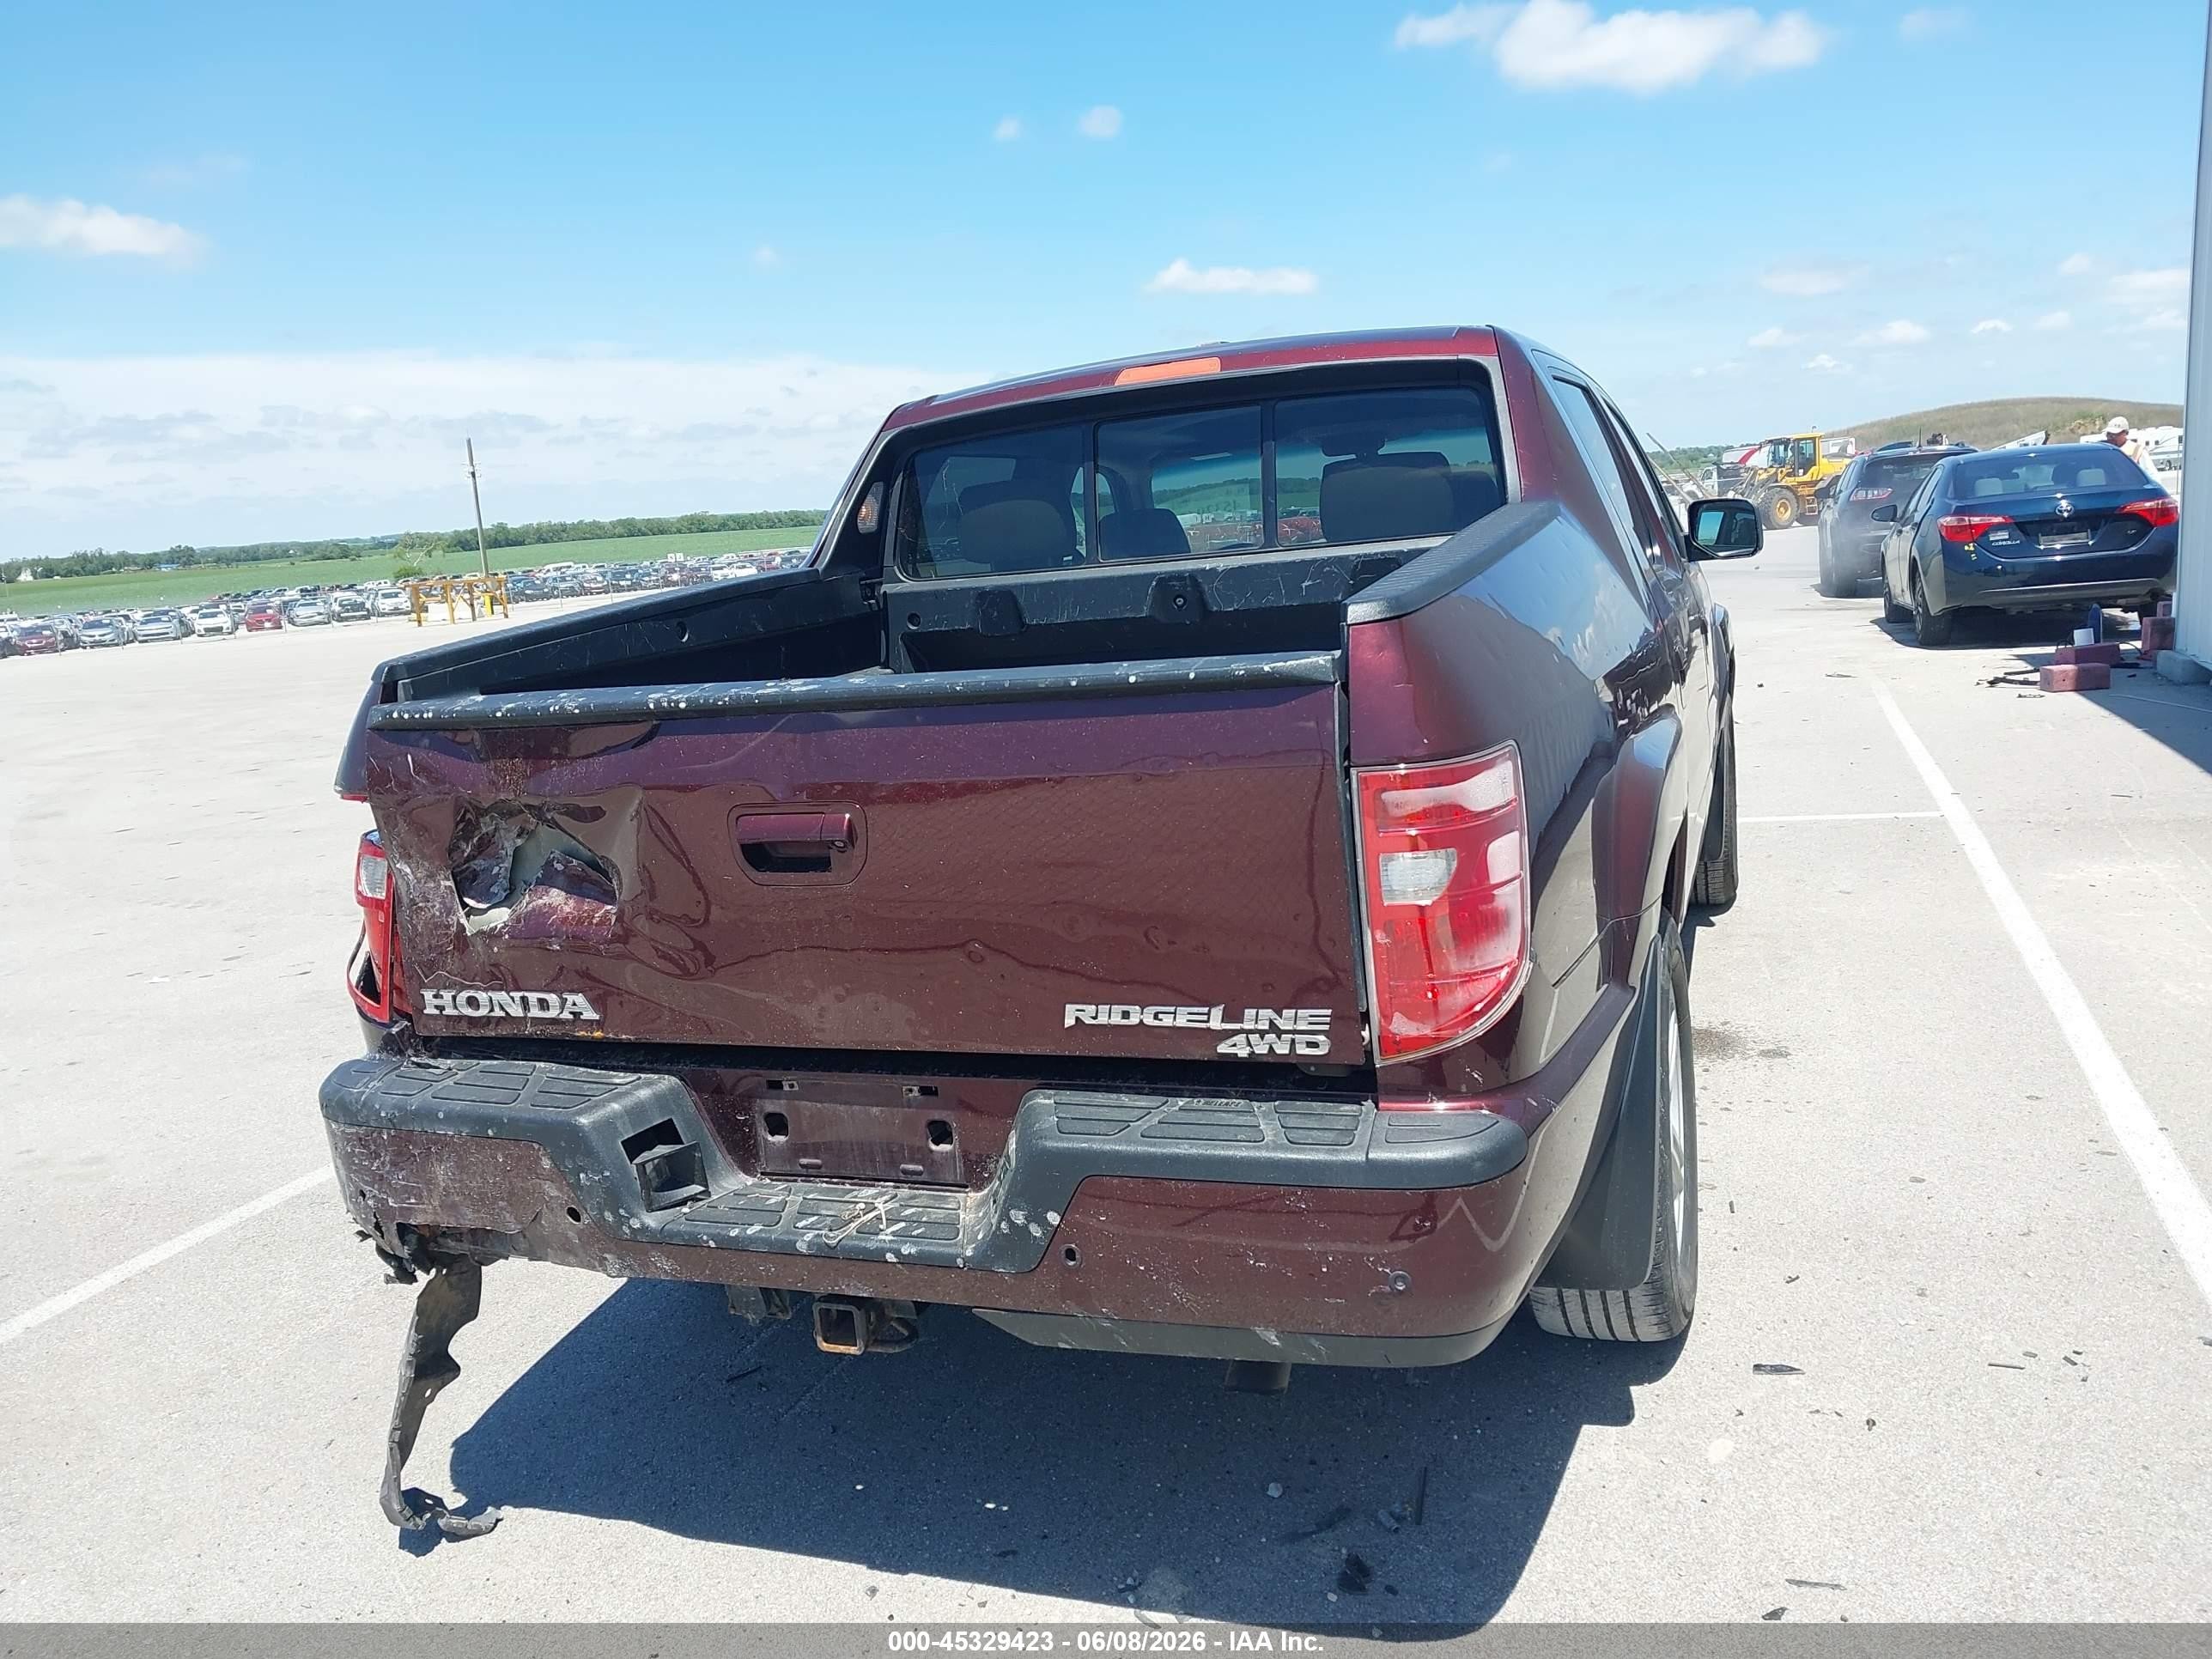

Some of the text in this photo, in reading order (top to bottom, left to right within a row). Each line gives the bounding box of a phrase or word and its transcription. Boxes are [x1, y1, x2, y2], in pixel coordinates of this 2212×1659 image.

[420, 989, 600, 1020] HONDA
[1064, 1003, 1332, 1030] RIDGELINE
[1216, 1033, 1331, 1058] 4WD
